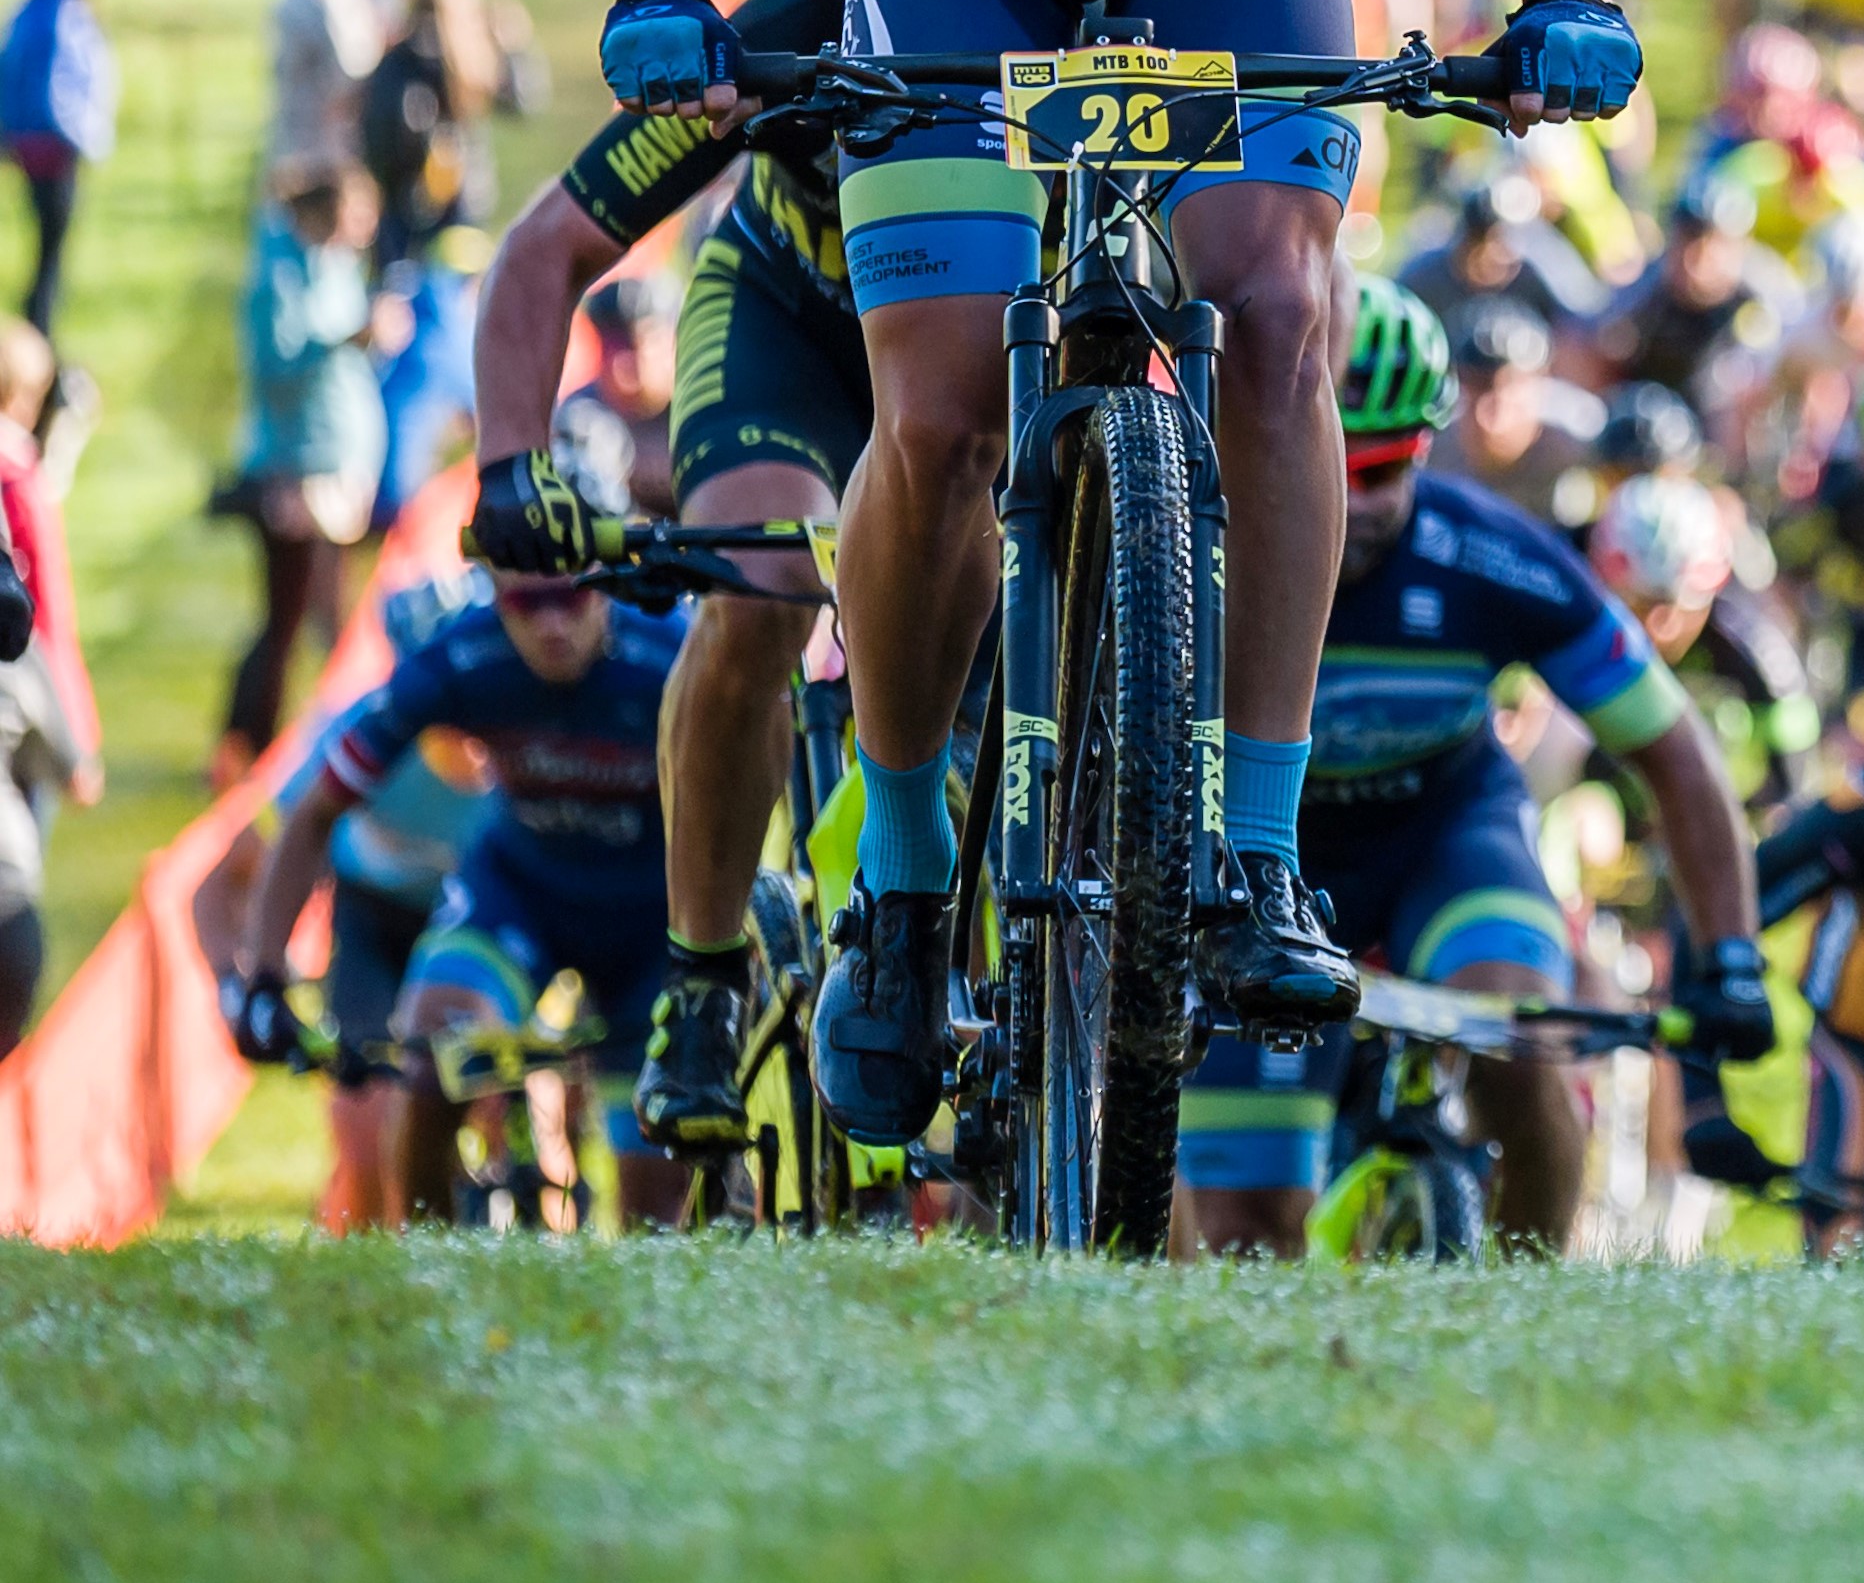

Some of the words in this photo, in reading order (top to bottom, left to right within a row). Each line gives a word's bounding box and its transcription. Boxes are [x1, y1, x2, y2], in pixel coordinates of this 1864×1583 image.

[713, 41, 727, 80] GIRO
[1093, 55, 1129, 71] MTB
[1136, 55, 1169, 71] 100
[1521, 46, 1533, 86] GIRO
[1080, 93, 1170, 153] 20
[1003, 741, 1031, 832] FOX
[1201, 746, 1225, 839] FOX
